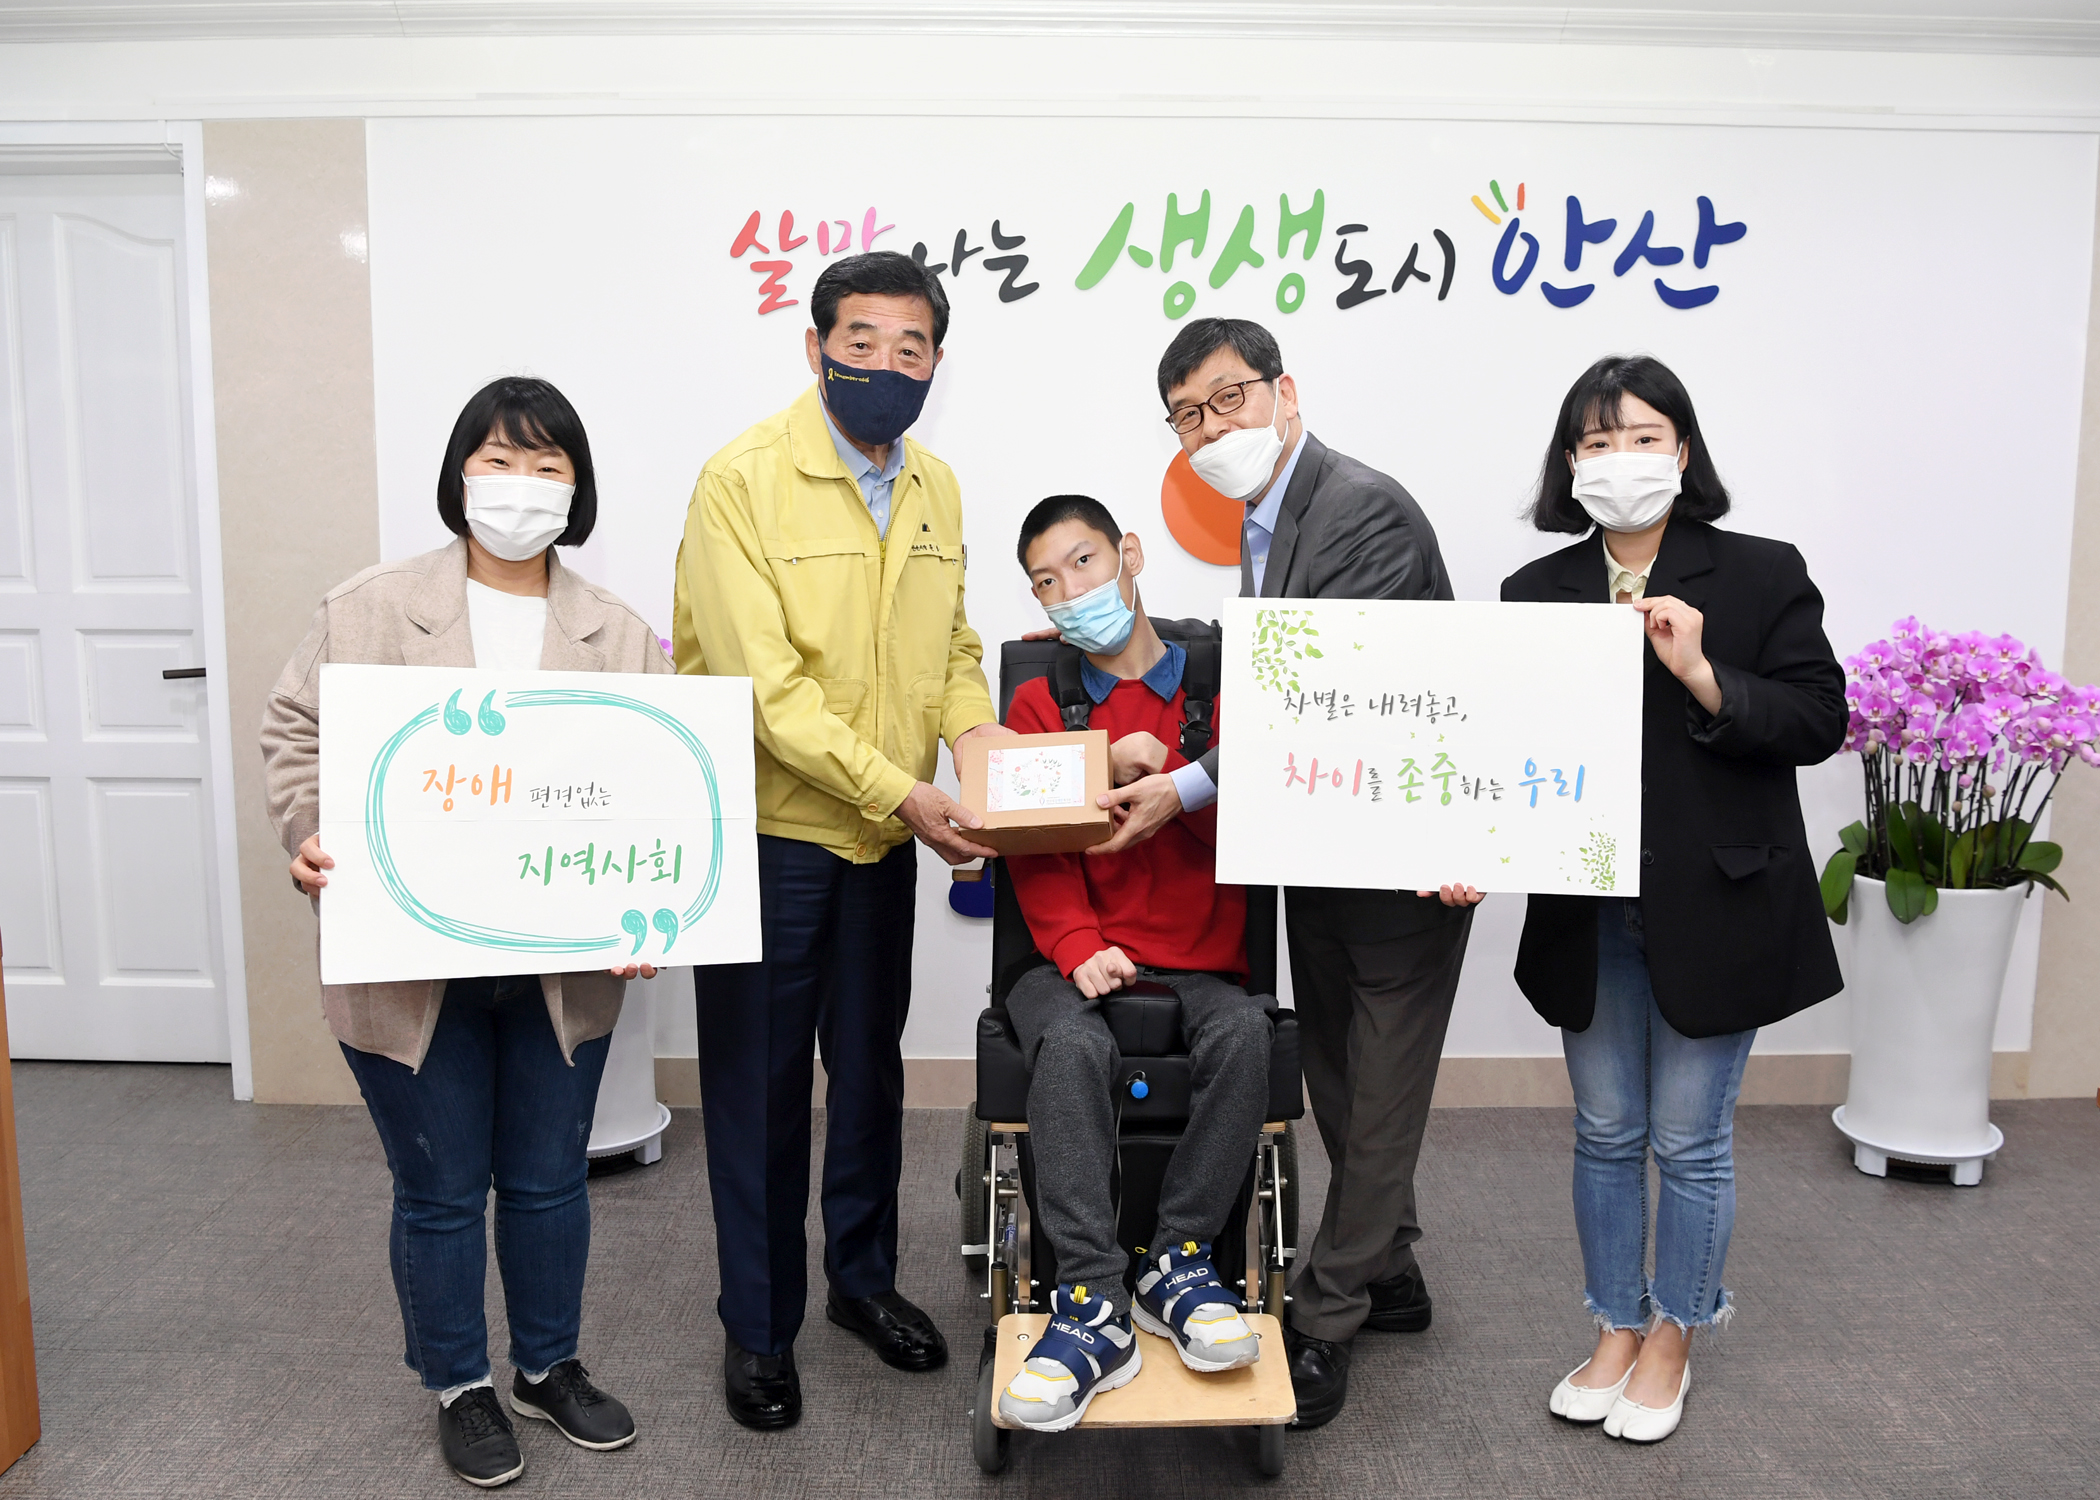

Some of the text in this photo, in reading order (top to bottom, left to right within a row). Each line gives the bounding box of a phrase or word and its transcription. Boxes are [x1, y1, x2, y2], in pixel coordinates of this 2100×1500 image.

[1075, 189, 1456, 320] 생생도시
[1491, 195, 1747, 309] 안산
[1282, 689, 1468, 724] 차별은 내려놓고,
[423, 764, 612, 812] 장애 편견없는
[1283, 752, 1585, 808] 차이를 존중하는 우리
[519, 838, 682, 886] 지역사회
[1165, 1267, 1209, 1290] HEAD
[1050, 1320, 1095, 1345] HEAD
